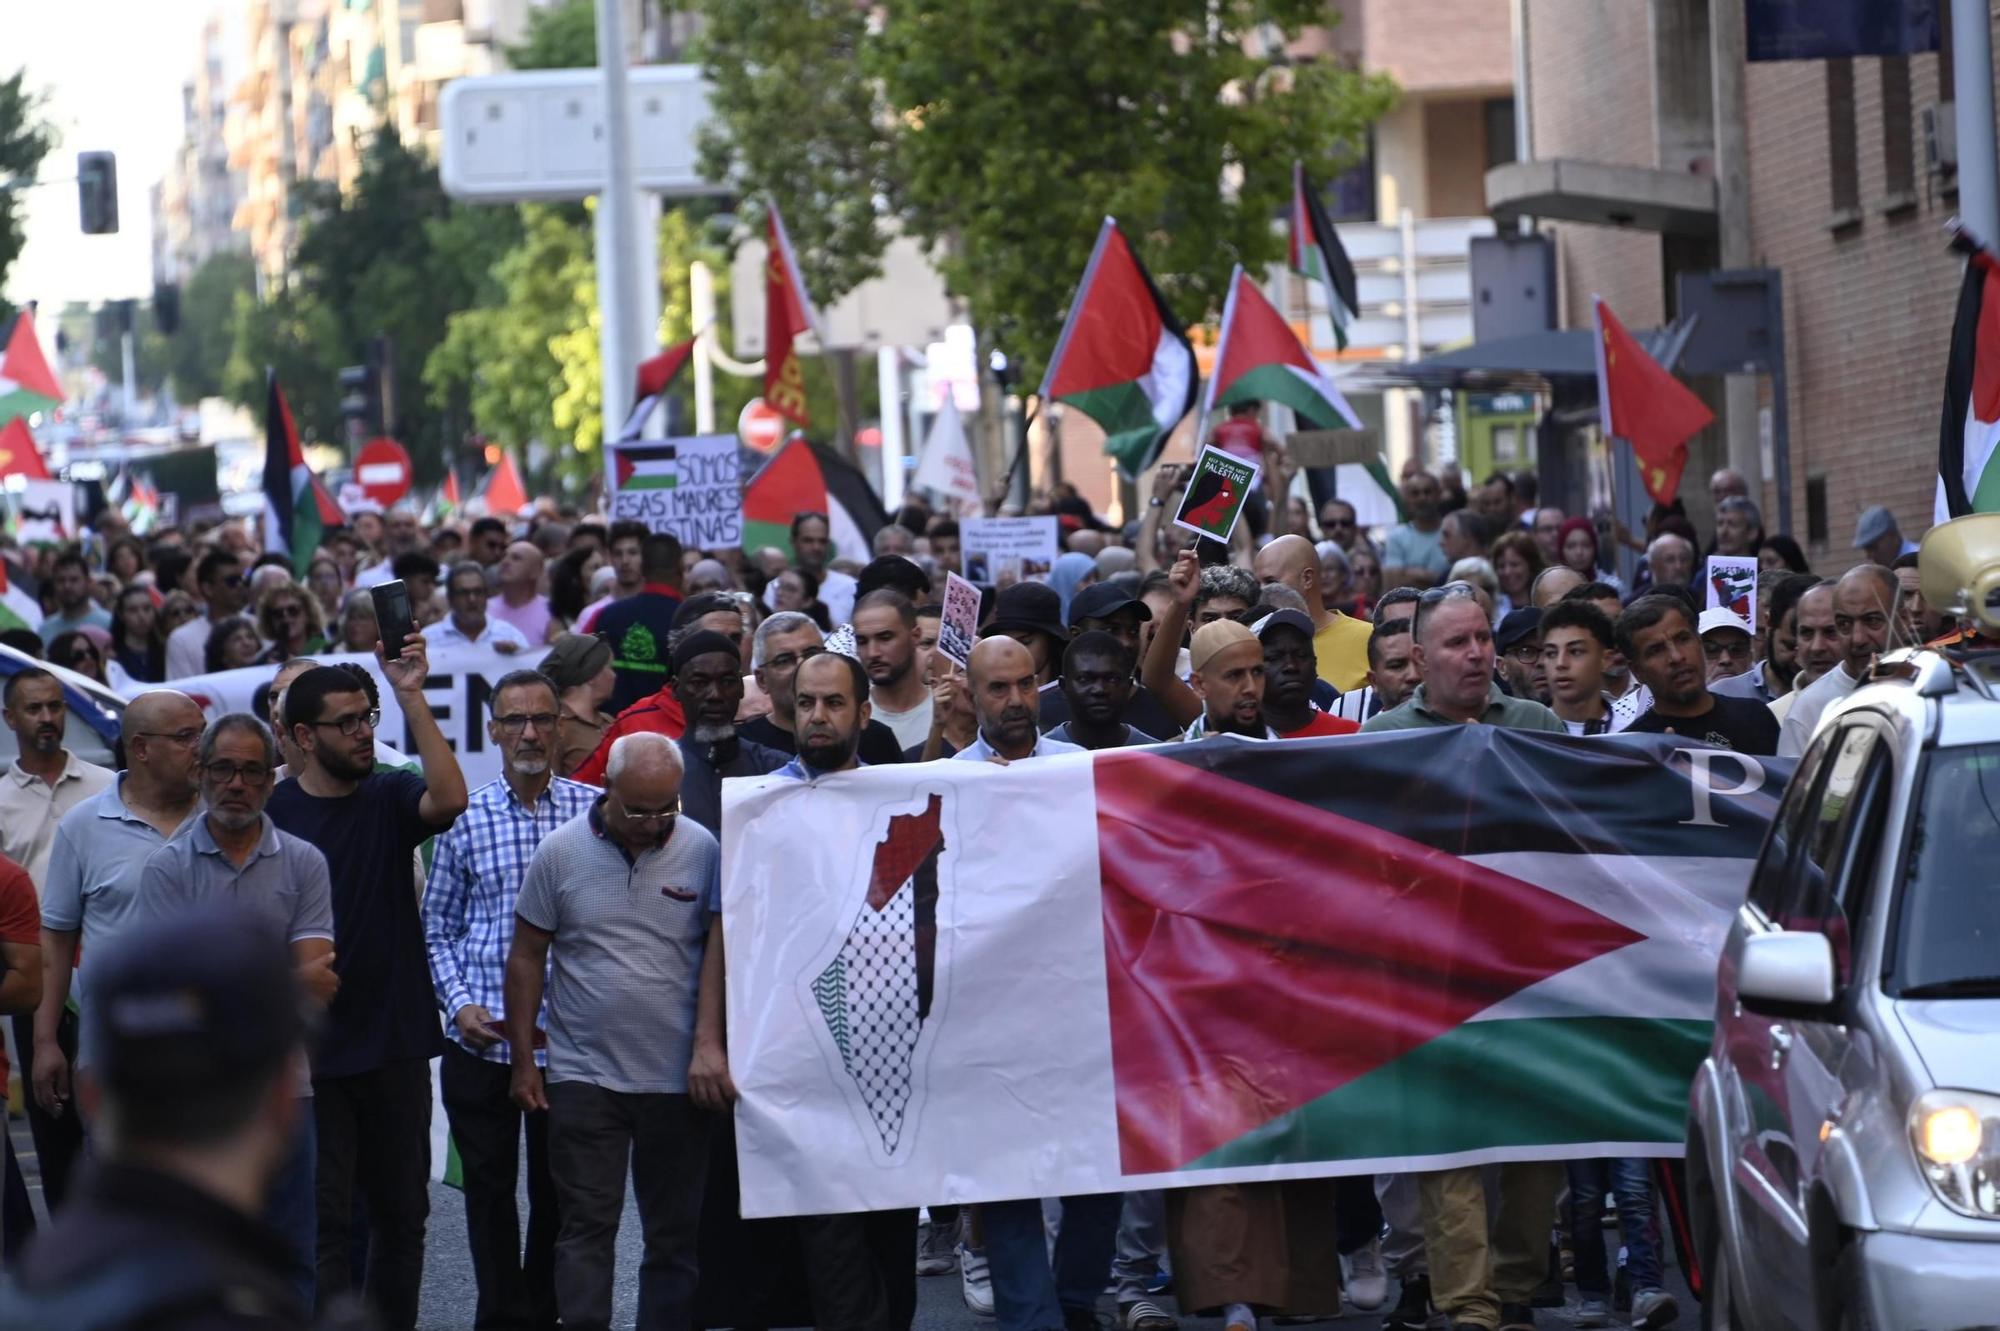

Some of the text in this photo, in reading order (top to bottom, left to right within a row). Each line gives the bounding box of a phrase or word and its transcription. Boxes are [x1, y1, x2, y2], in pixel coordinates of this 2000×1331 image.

[676, 452, 738, 486] SOMOS
[1204, 461, 1246, 485] PALESTINE
[616, 487, 741, 518] ESAS MADRES
[1675, 747, 1766, 828] P
